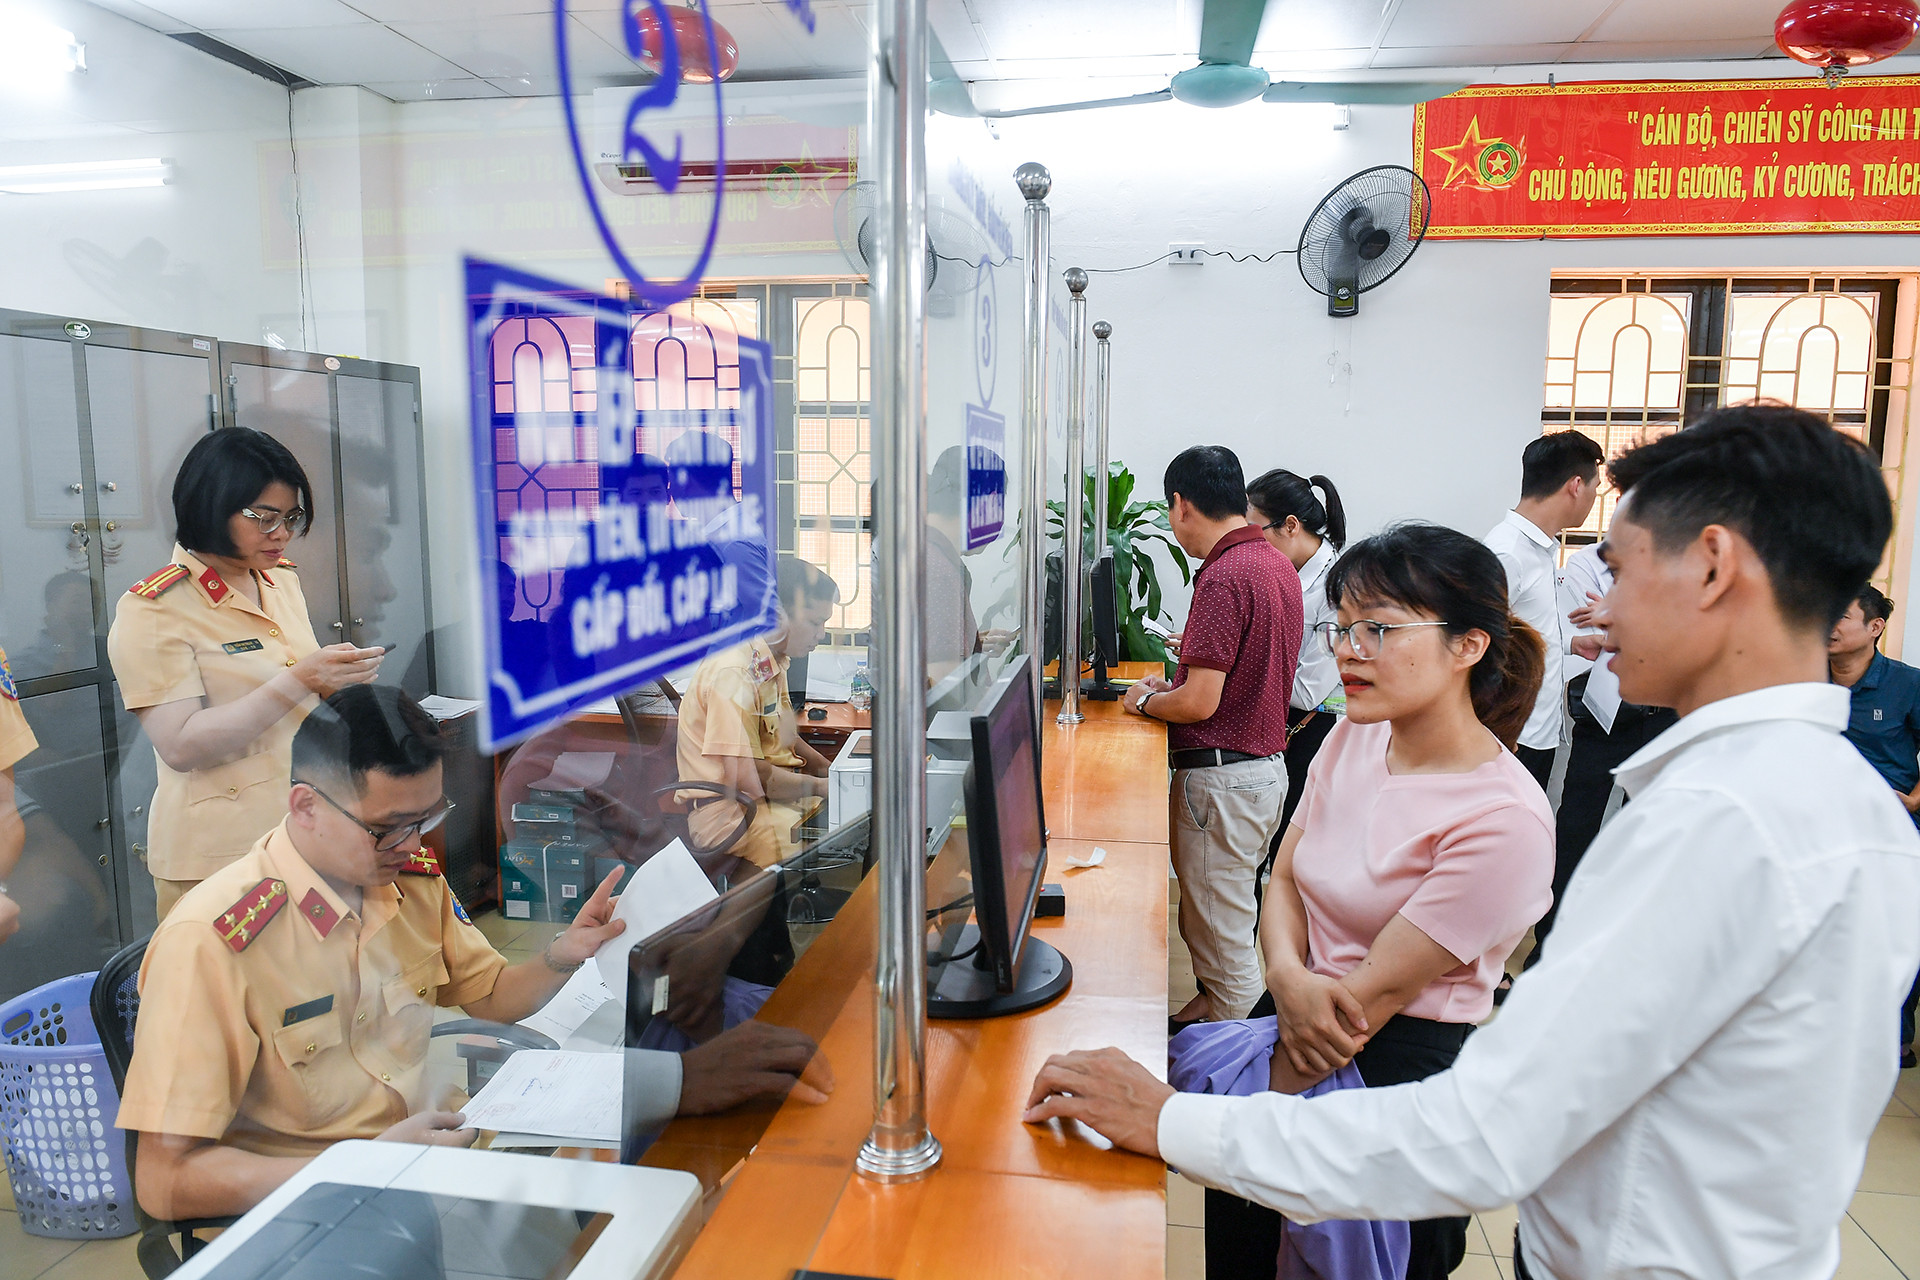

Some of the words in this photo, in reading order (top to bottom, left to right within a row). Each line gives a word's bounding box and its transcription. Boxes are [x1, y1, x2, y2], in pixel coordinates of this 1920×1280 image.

[1686, 105, 1717, 152] BỘ,
[1723, 99, 1783, 145] CHIẾN
[1787, 103, 1813, 143] SỸ
[1818, 102, 1873, 142] CÔNG
[1877, 108, 1907, 141] AN
[1528, 155, 1567, 202] CHỦ
[1570, 161, 1628, 208] ĐỘNG,
[1633, 160, 1673, 200] NÊU
[1676, 163, 1748, 203] GƯƠNG,
[1752, 151, 1779, 198] KỶ
[1783, 161, 1856, 202] CƯƠNG,
[982, 295, 992, 367] 3
